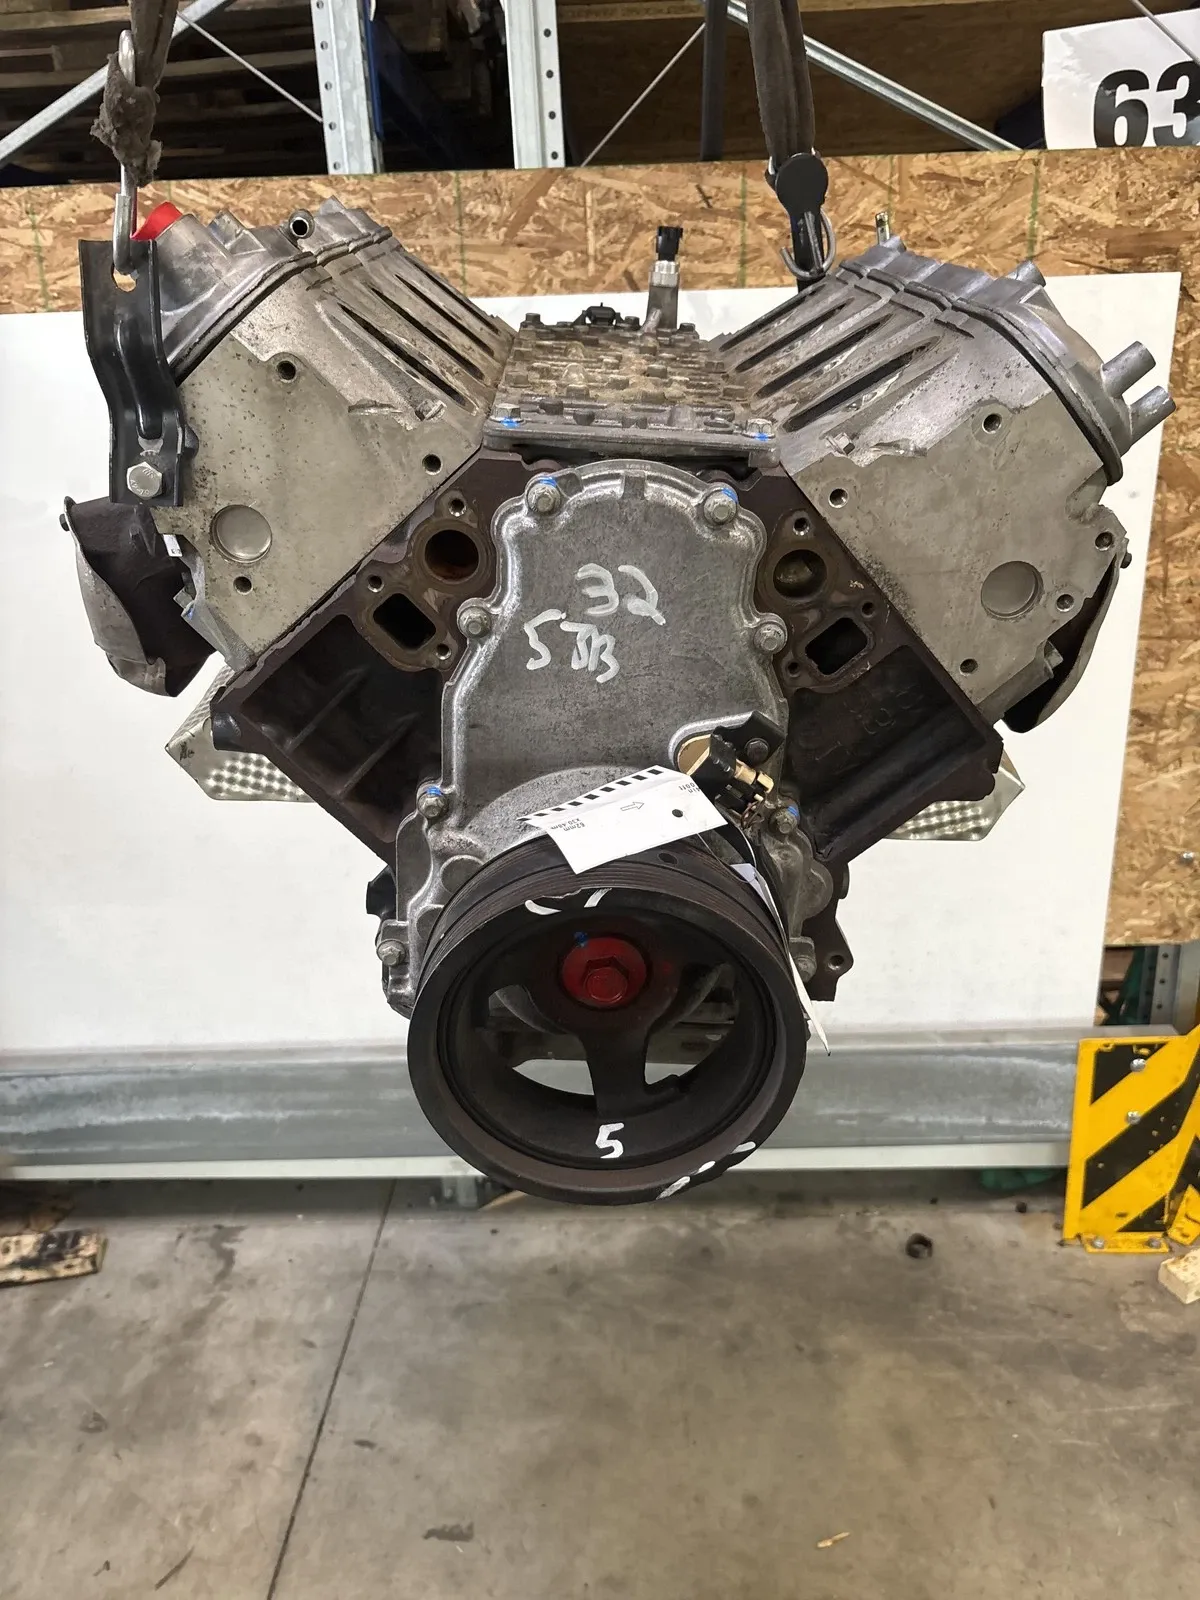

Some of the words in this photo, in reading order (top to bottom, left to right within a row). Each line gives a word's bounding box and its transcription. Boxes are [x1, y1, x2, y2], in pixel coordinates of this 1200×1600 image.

[1093, 60, 1200, 148] 63
[575, 562, 667, 627] 32
[594, 1121, 625, 1159] 5
